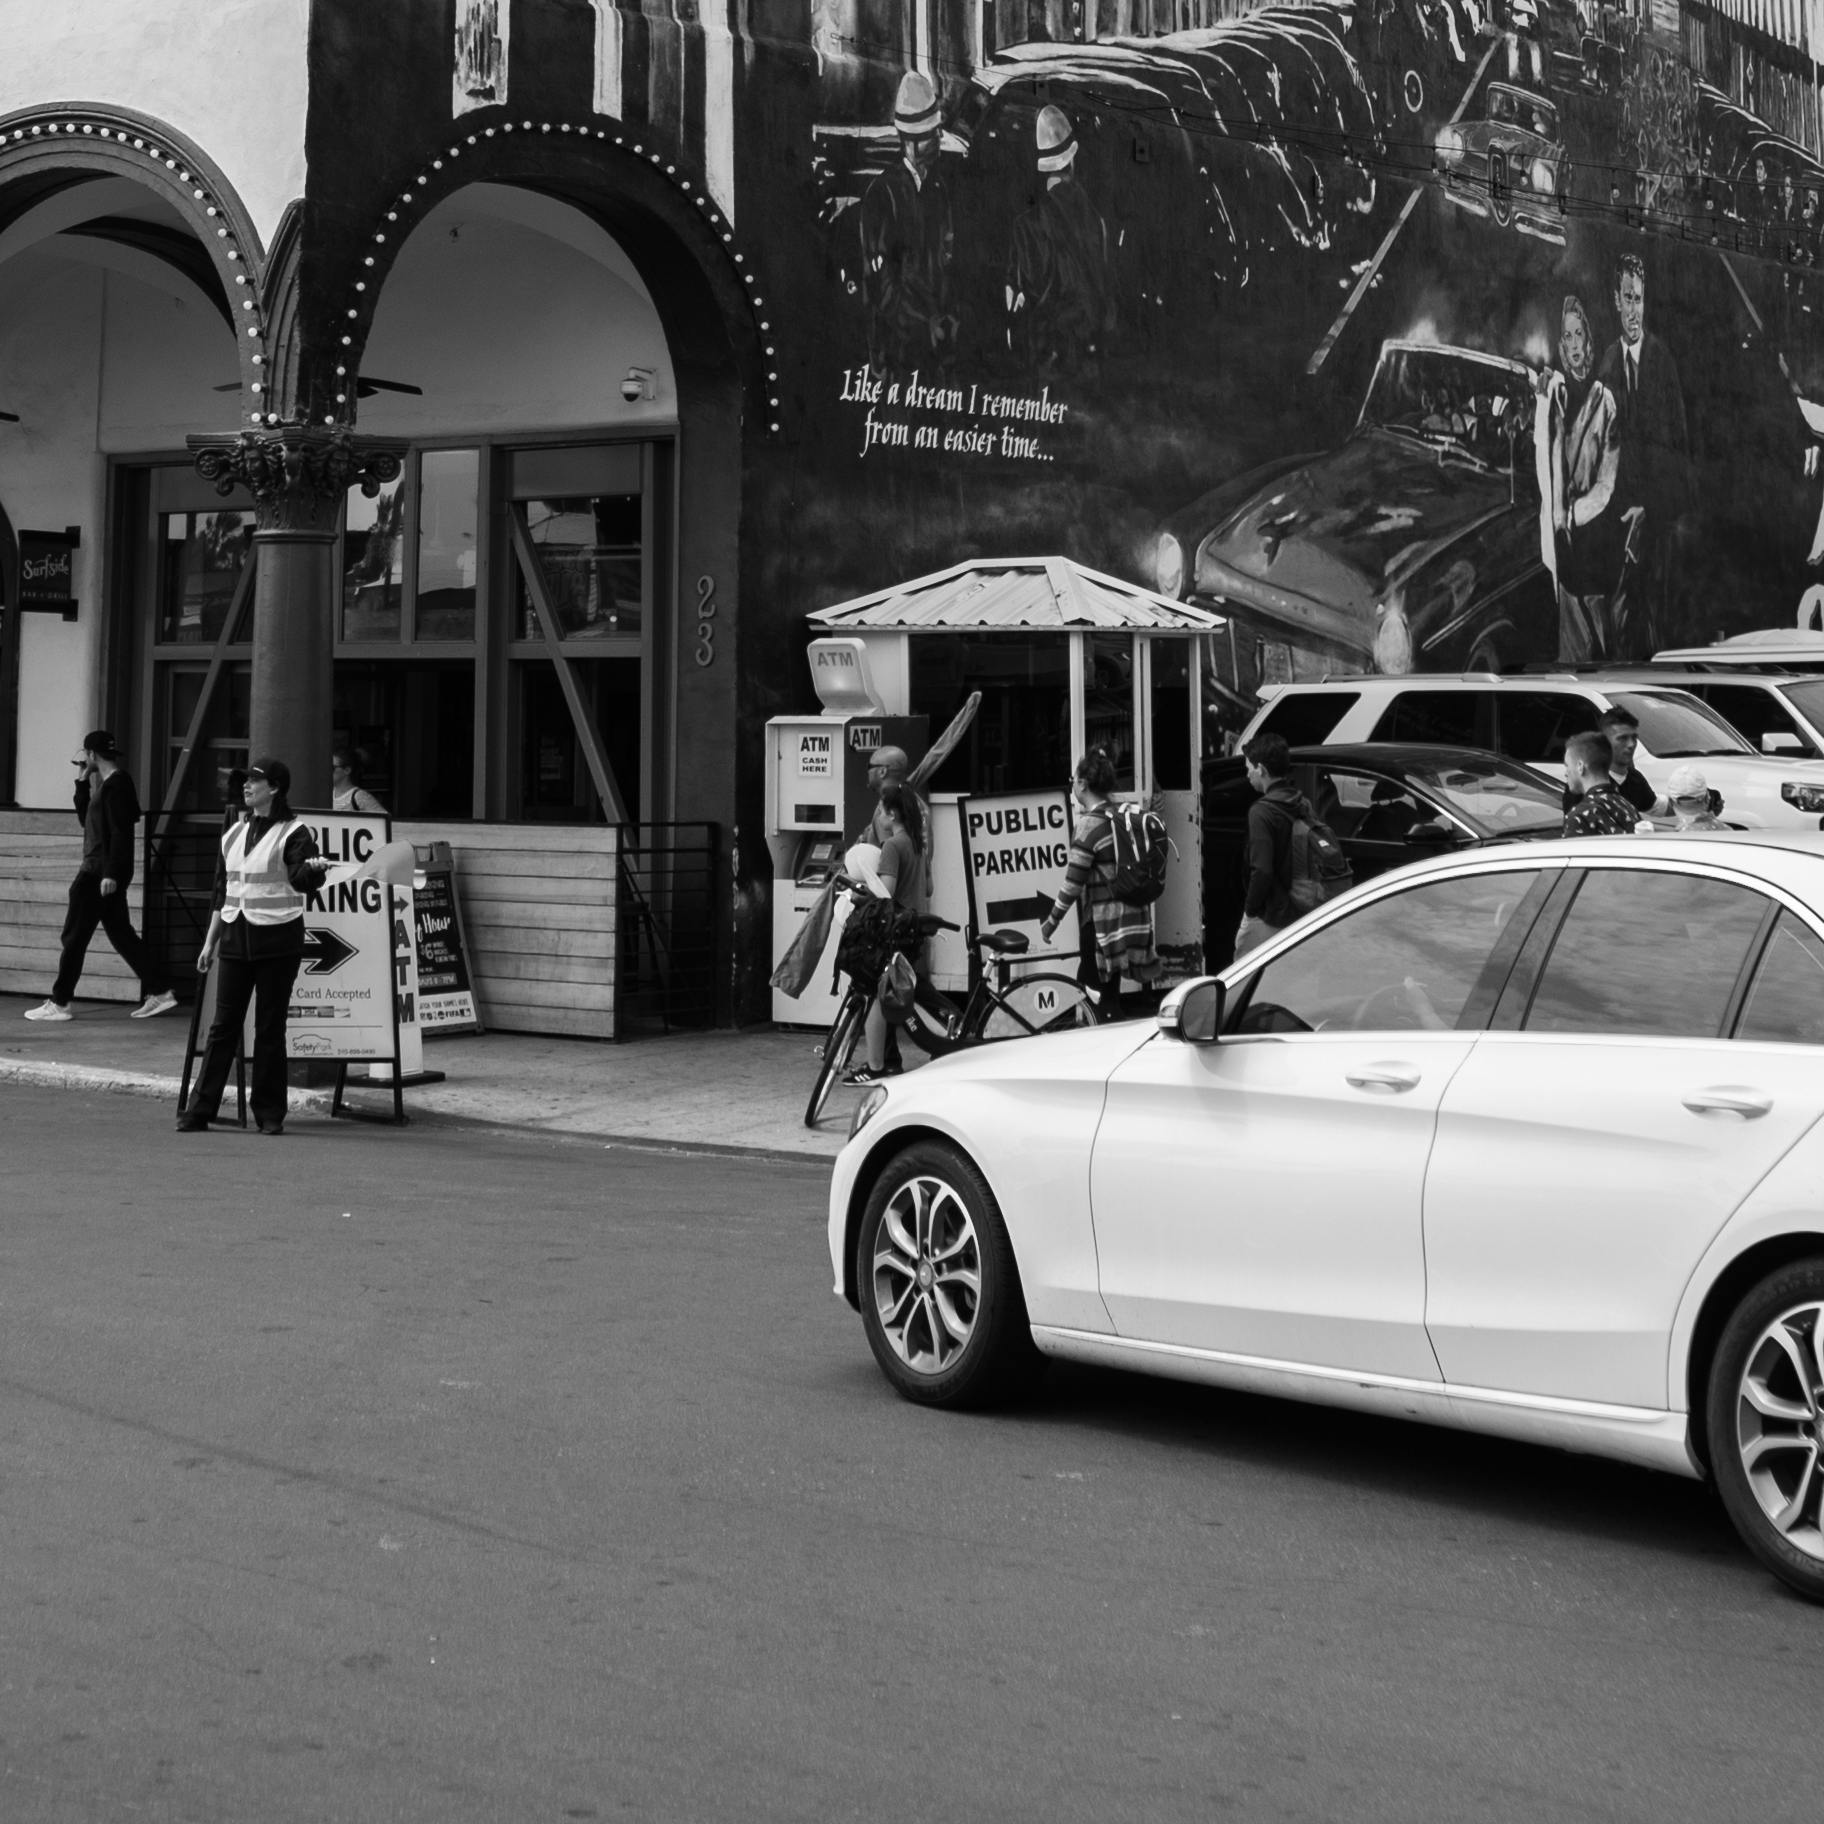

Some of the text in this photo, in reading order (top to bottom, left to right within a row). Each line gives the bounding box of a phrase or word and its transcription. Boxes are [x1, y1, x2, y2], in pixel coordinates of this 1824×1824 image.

[839, 363, 1068, 424] Like a dream I remember
[860, 407, 909, 458] from
[914, 424, 939, 449] an
[944, 424, 997, 456] easier
[23, 553, 70, 580] Surfside
[816, 651, 854, 668] ATM
[800, 736, 831, 753] ATM
[852, 727, 881, 750] ATM
[802, 757, 828, 765] CASH
[802, 765, 828, 773] HERE
[969, 804, 1065, 838] PUBLIC
[974, 843, 1068, 877] PARKING
[305, 879, 383, 915] KING
[395, 919, 415, 1024] ATM
[296, 987, 372, 1002] Card Accepted
[1038, 991, 1055, 1009] M
